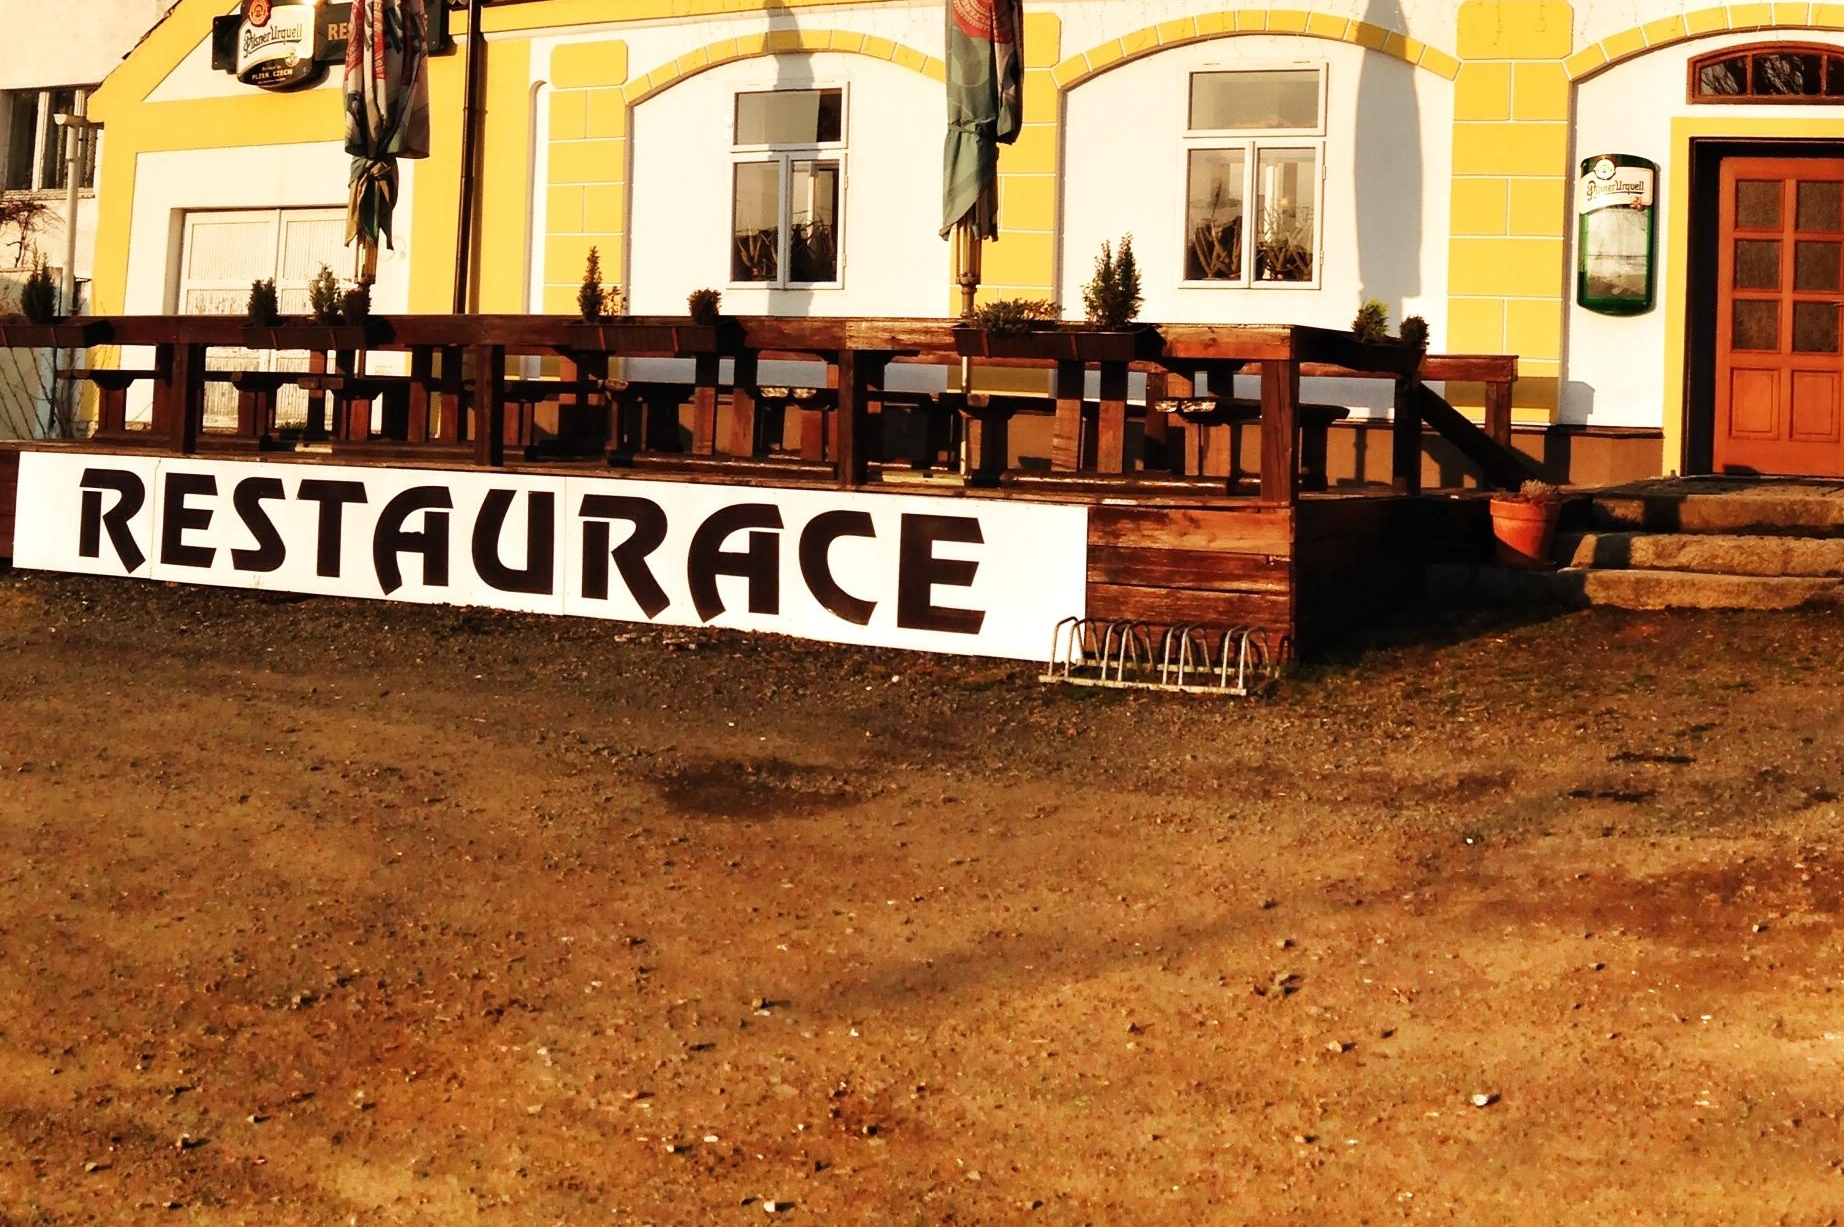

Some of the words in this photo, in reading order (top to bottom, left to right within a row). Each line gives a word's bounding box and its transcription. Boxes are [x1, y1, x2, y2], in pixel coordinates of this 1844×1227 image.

[270, 25, 302, 45] Urquell
[1614, 180, 1644, 195] Urquell
[79, 467, 986, 635] RESTAURACE
